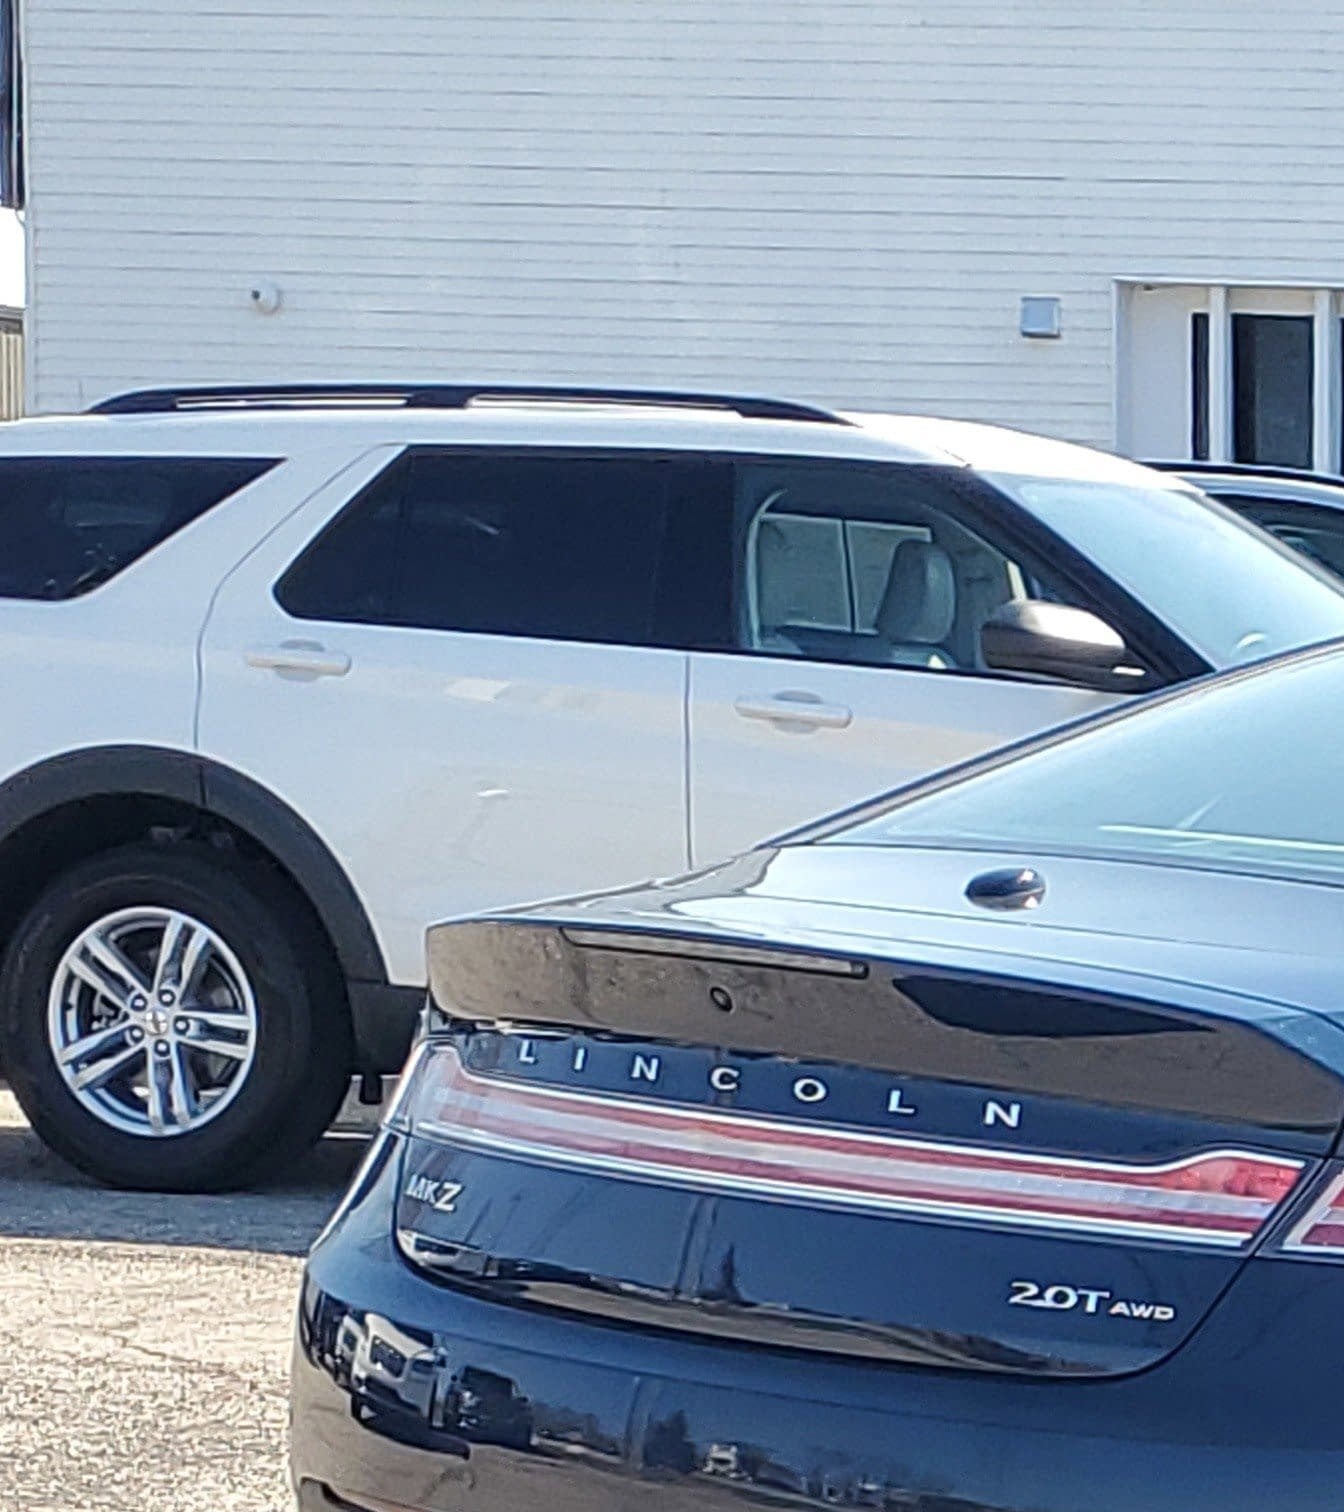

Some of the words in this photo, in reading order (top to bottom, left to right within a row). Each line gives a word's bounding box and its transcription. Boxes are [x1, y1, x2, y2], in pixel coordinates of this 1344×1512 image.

[518, 1040, 1021, 1128] LINCOLN
[405, 1173, 463, 1212] MKZ
[1108, 1301, 1176, 1321] AWD
